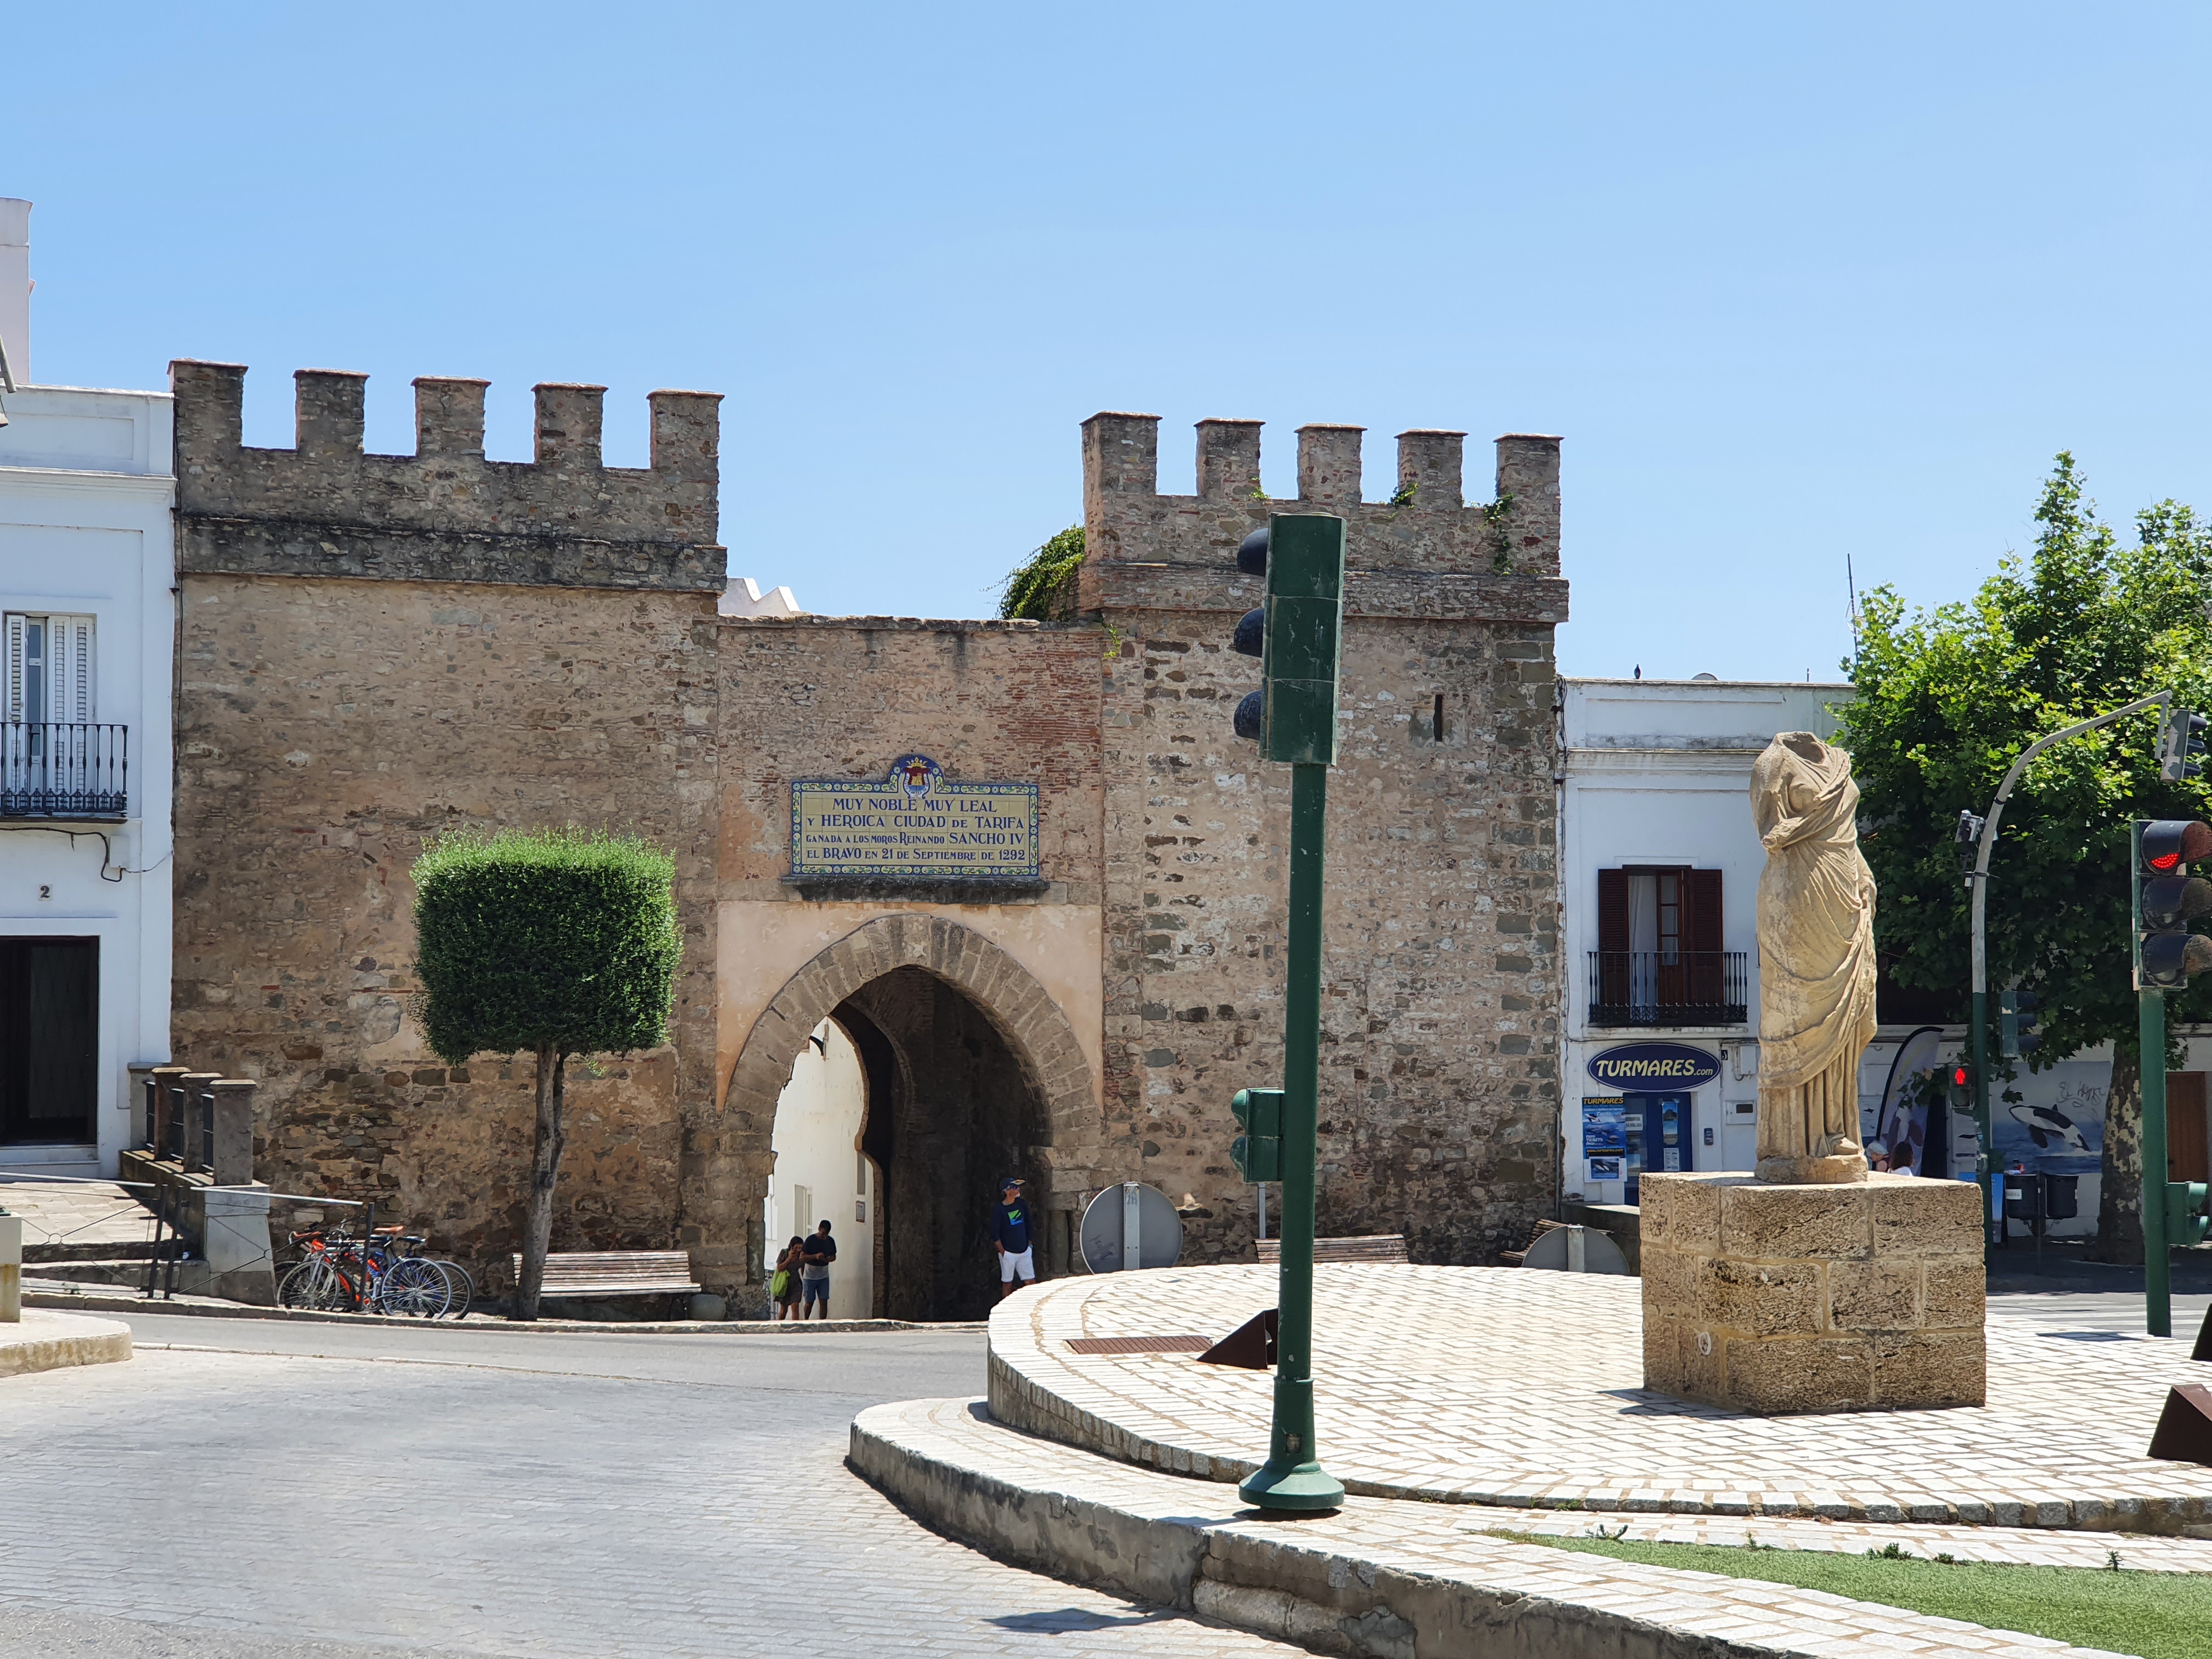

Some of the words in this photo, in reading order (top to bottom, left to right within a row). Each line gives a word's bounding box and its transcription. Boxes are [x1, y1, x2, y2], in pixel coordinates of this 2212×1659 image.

[832, 798, 864, 810] MUY
[868, 798, 917, 811] NOBLE
[923, 798, 955, 811] MUY
[960, 799, 997, 812] LEAL
[807, 817, 815, 826] Y
[821, 814, 885, 829] HEROICA
[894, 815, 946, 828] CIUDAD
[952, 819, 968, 828] DE
[974, 816, 1024, 830] TARIFA
[806, 834, 842, 843] GANADA
[845, 835, 851, 843] A
[853, 834, 870, 843] LOS
[871, 835, 898, 845] MOROS
[949, 832, 1006, 845] SANCHO
[1010, 833, 1024, 845] IV
[807, 850, 820, 859] EL
[823, 848, 862, 860] BRAVO
[865, 851, 878, 859] EN
[882, 848, 893, 859] 21
[897, 851, 910, 859] DE
[981, 852, 994, 860] DE
[998, 849, 1025, 860] 1292
[40, 885, 50, 898] 2
